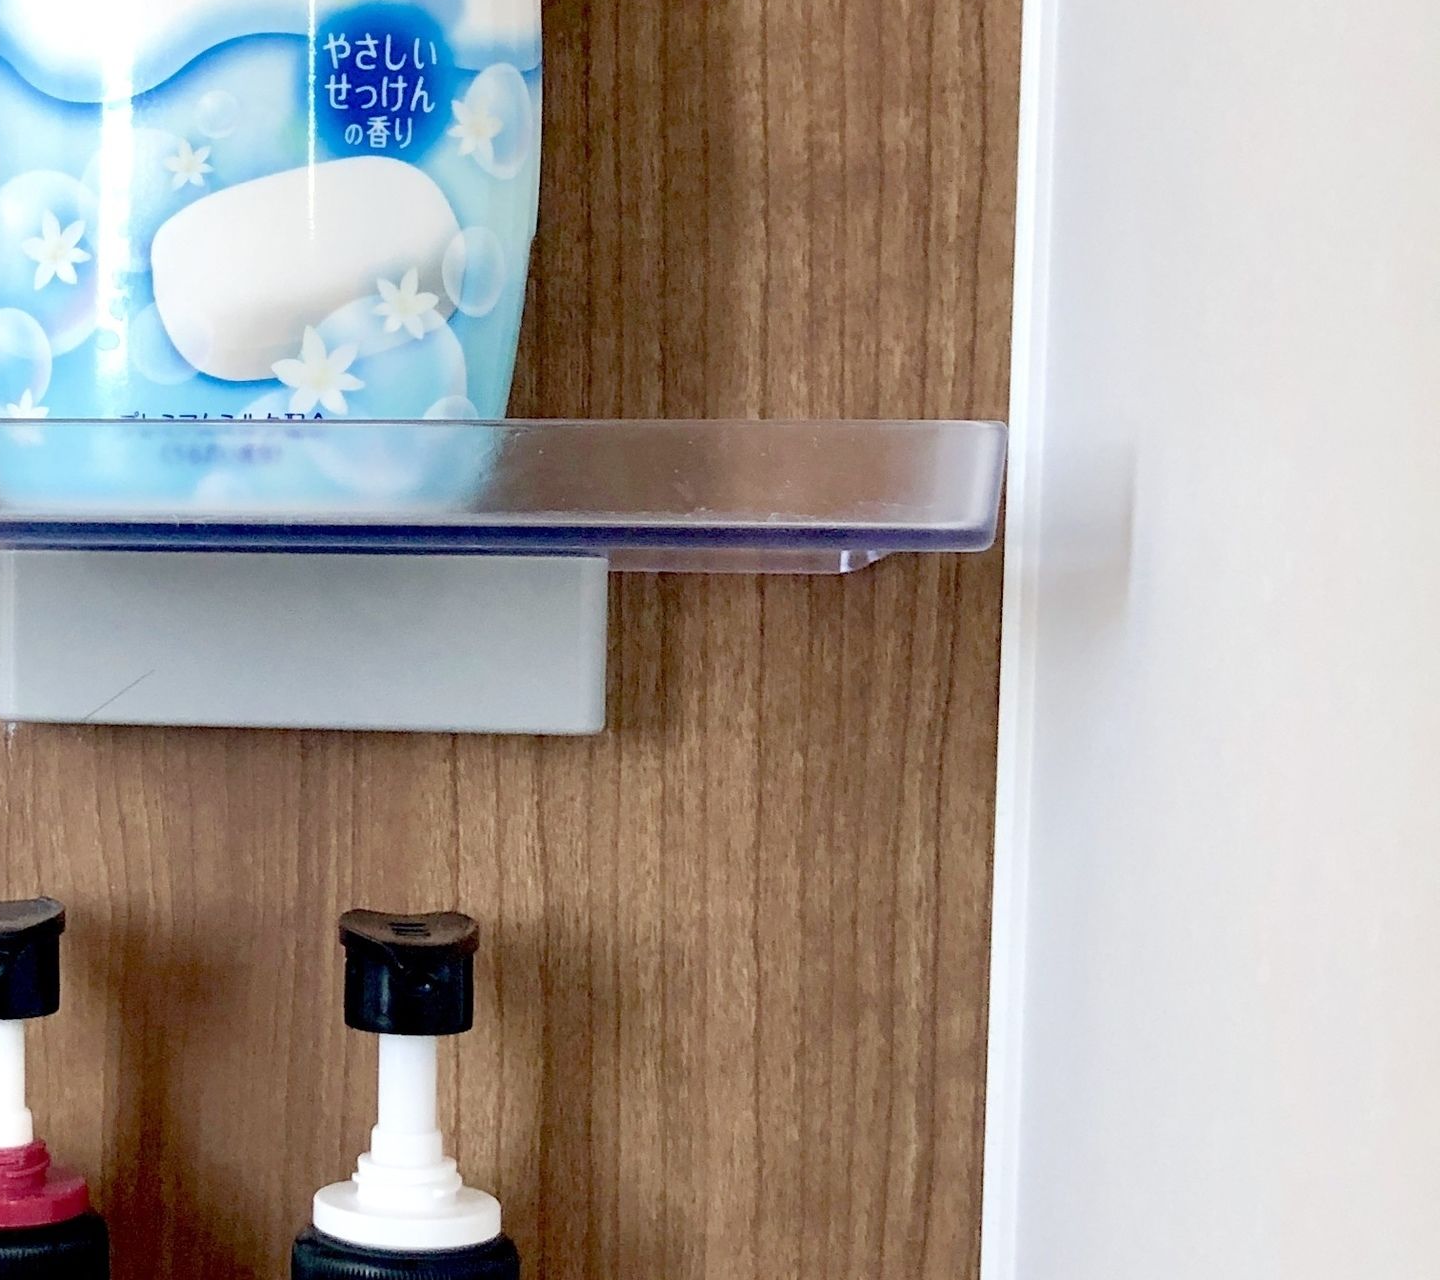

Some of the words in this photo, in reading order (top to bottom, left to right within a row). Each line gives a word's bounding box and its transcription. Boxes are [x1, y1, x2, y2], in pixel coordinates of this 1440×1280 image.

[323, 33, 437, 71] やさしい
[324, 74, 436, 114] せっけん
[344, 117, 413, 149] の香り
